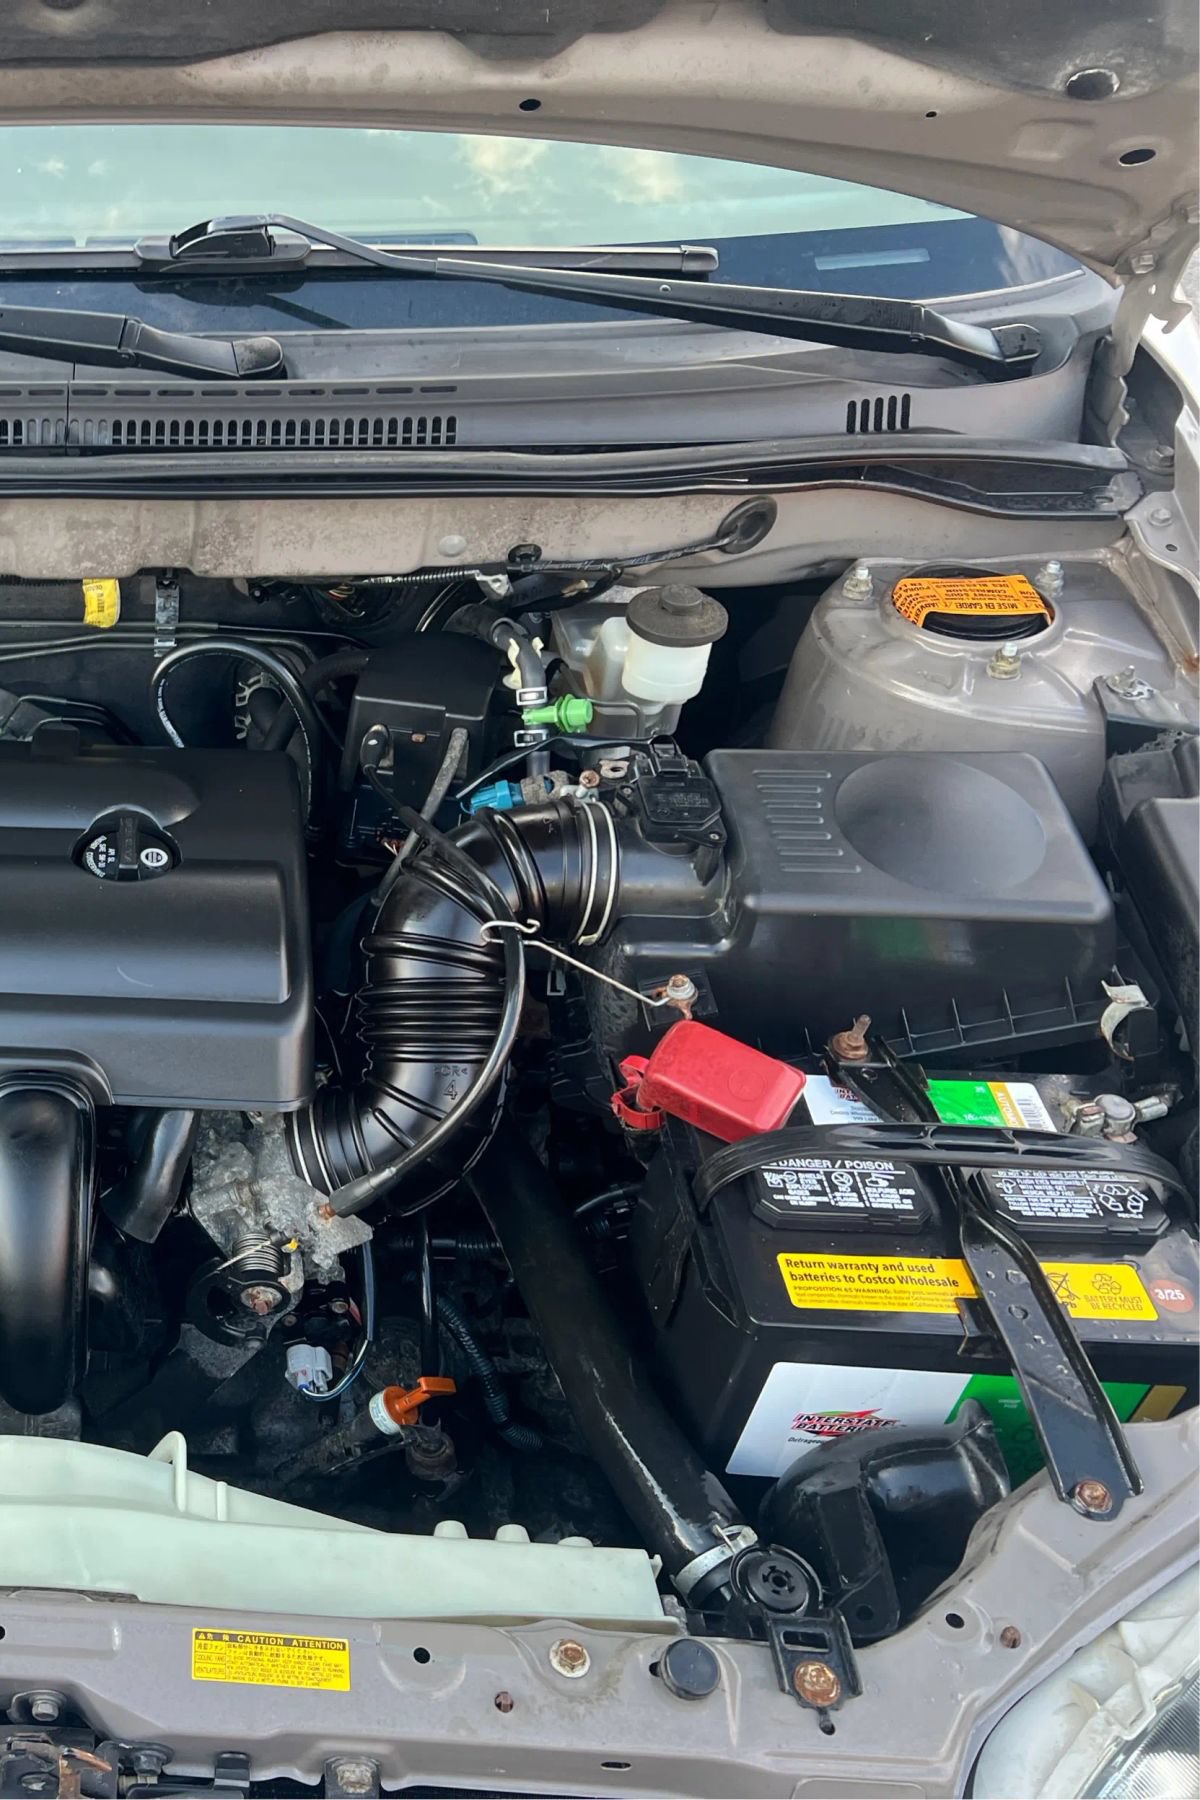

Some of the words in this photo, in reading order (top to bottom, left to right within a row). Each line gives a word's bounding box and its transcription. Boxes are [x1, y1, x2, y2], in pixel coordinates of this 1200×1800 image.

[778, 1159, 832, 1168] DANGER
[845, 1161, 895, 1170] POISON
[786, 1258, 825, 1269] Return
[827, 1261, 879, 1273] warranty
[882, 1262, 904, 1272] and
[907, 1263, 935, 1273] used
[790, 1272, 841, 1283] batteries
[843, 1274, 856, 1284] to
[858, 1274, 896, 1285] Costco
[897, 1275, 960, 1288] Wholesale
[1119, 1296, 1143, 1304] MUST
[1103, 1302, 1144, 1311] RECYCLED
[795, 1423, 866, 1432] BATTERI
[237, 1634, 284, 1646] CAUTION
[292, 1639, 344, 1650] ATTENTION
